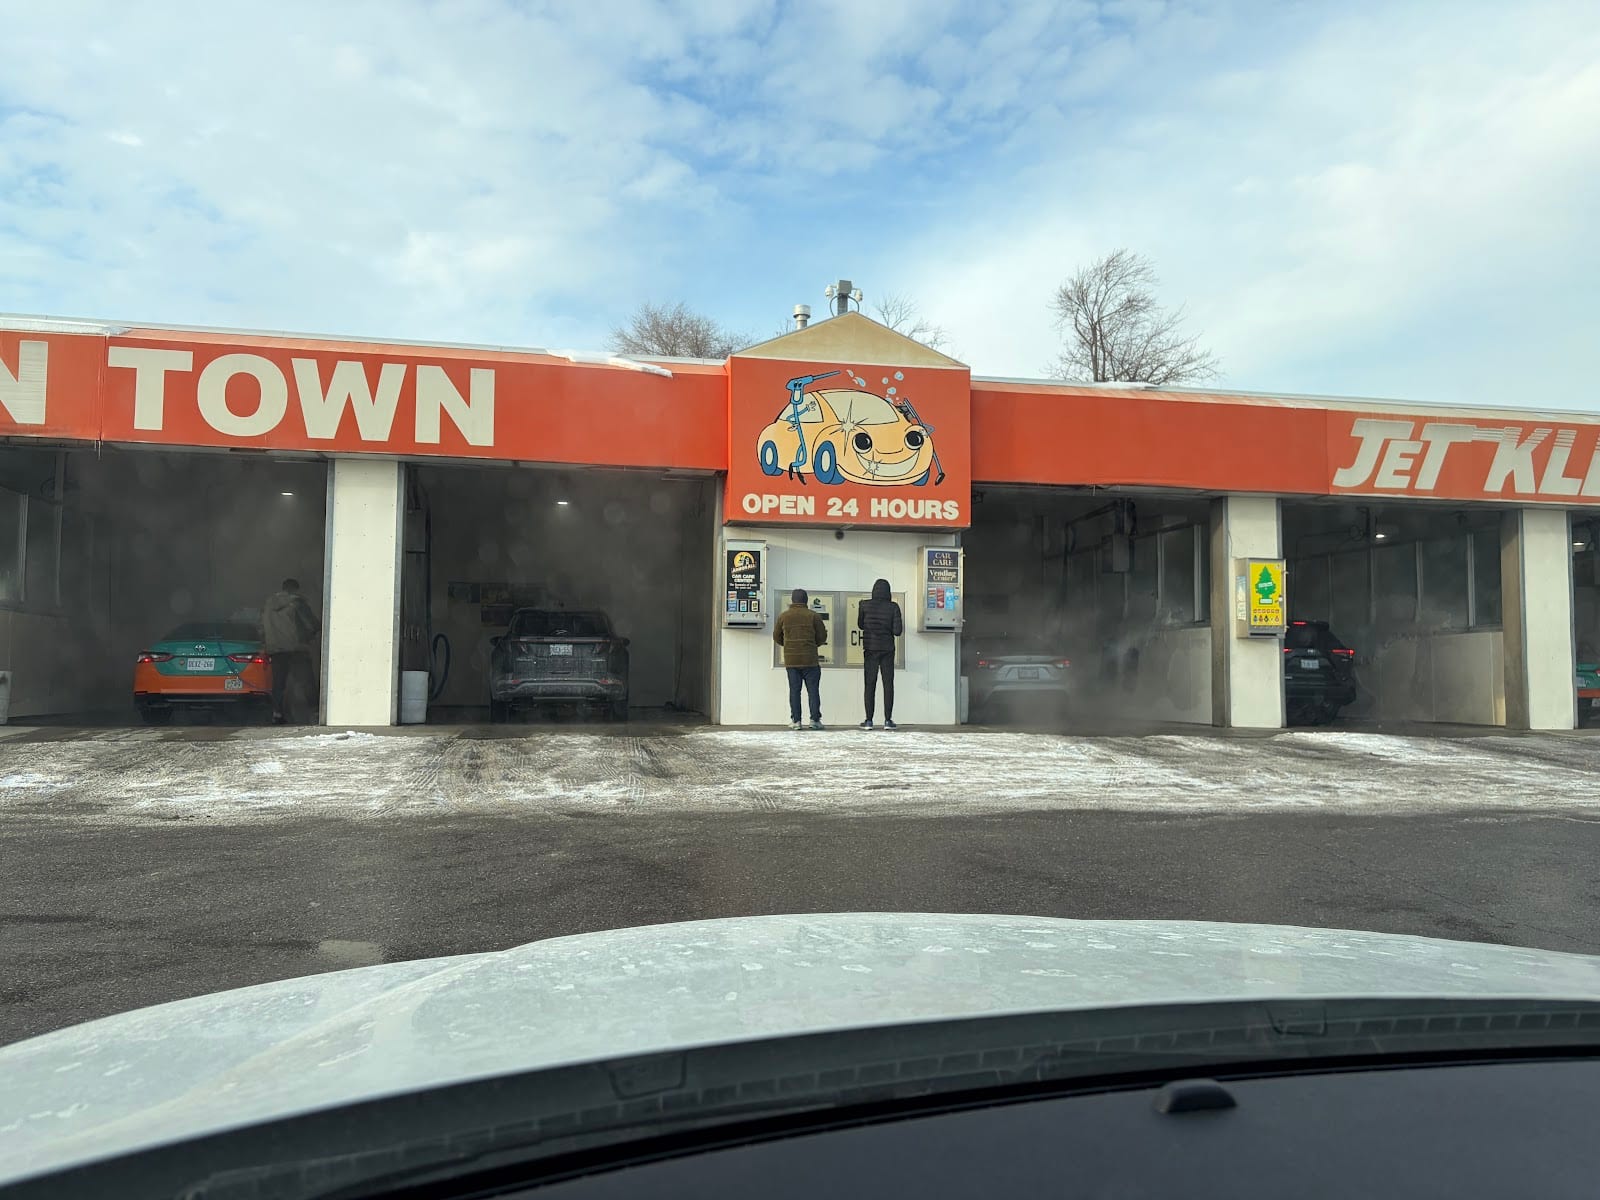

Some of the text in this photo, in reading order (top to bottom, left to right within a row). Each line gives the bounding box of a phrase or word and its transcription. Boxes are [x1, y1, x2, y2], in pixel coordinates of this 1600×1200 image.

[107, 346, 495, 447] TOWN
[1332, 418, 1478, 490] JET
[742, 493, 959, 520] OPEN 24 HOURS
[929, 570, 957, 578] Vending
[851, 630, 865, 647] CH
